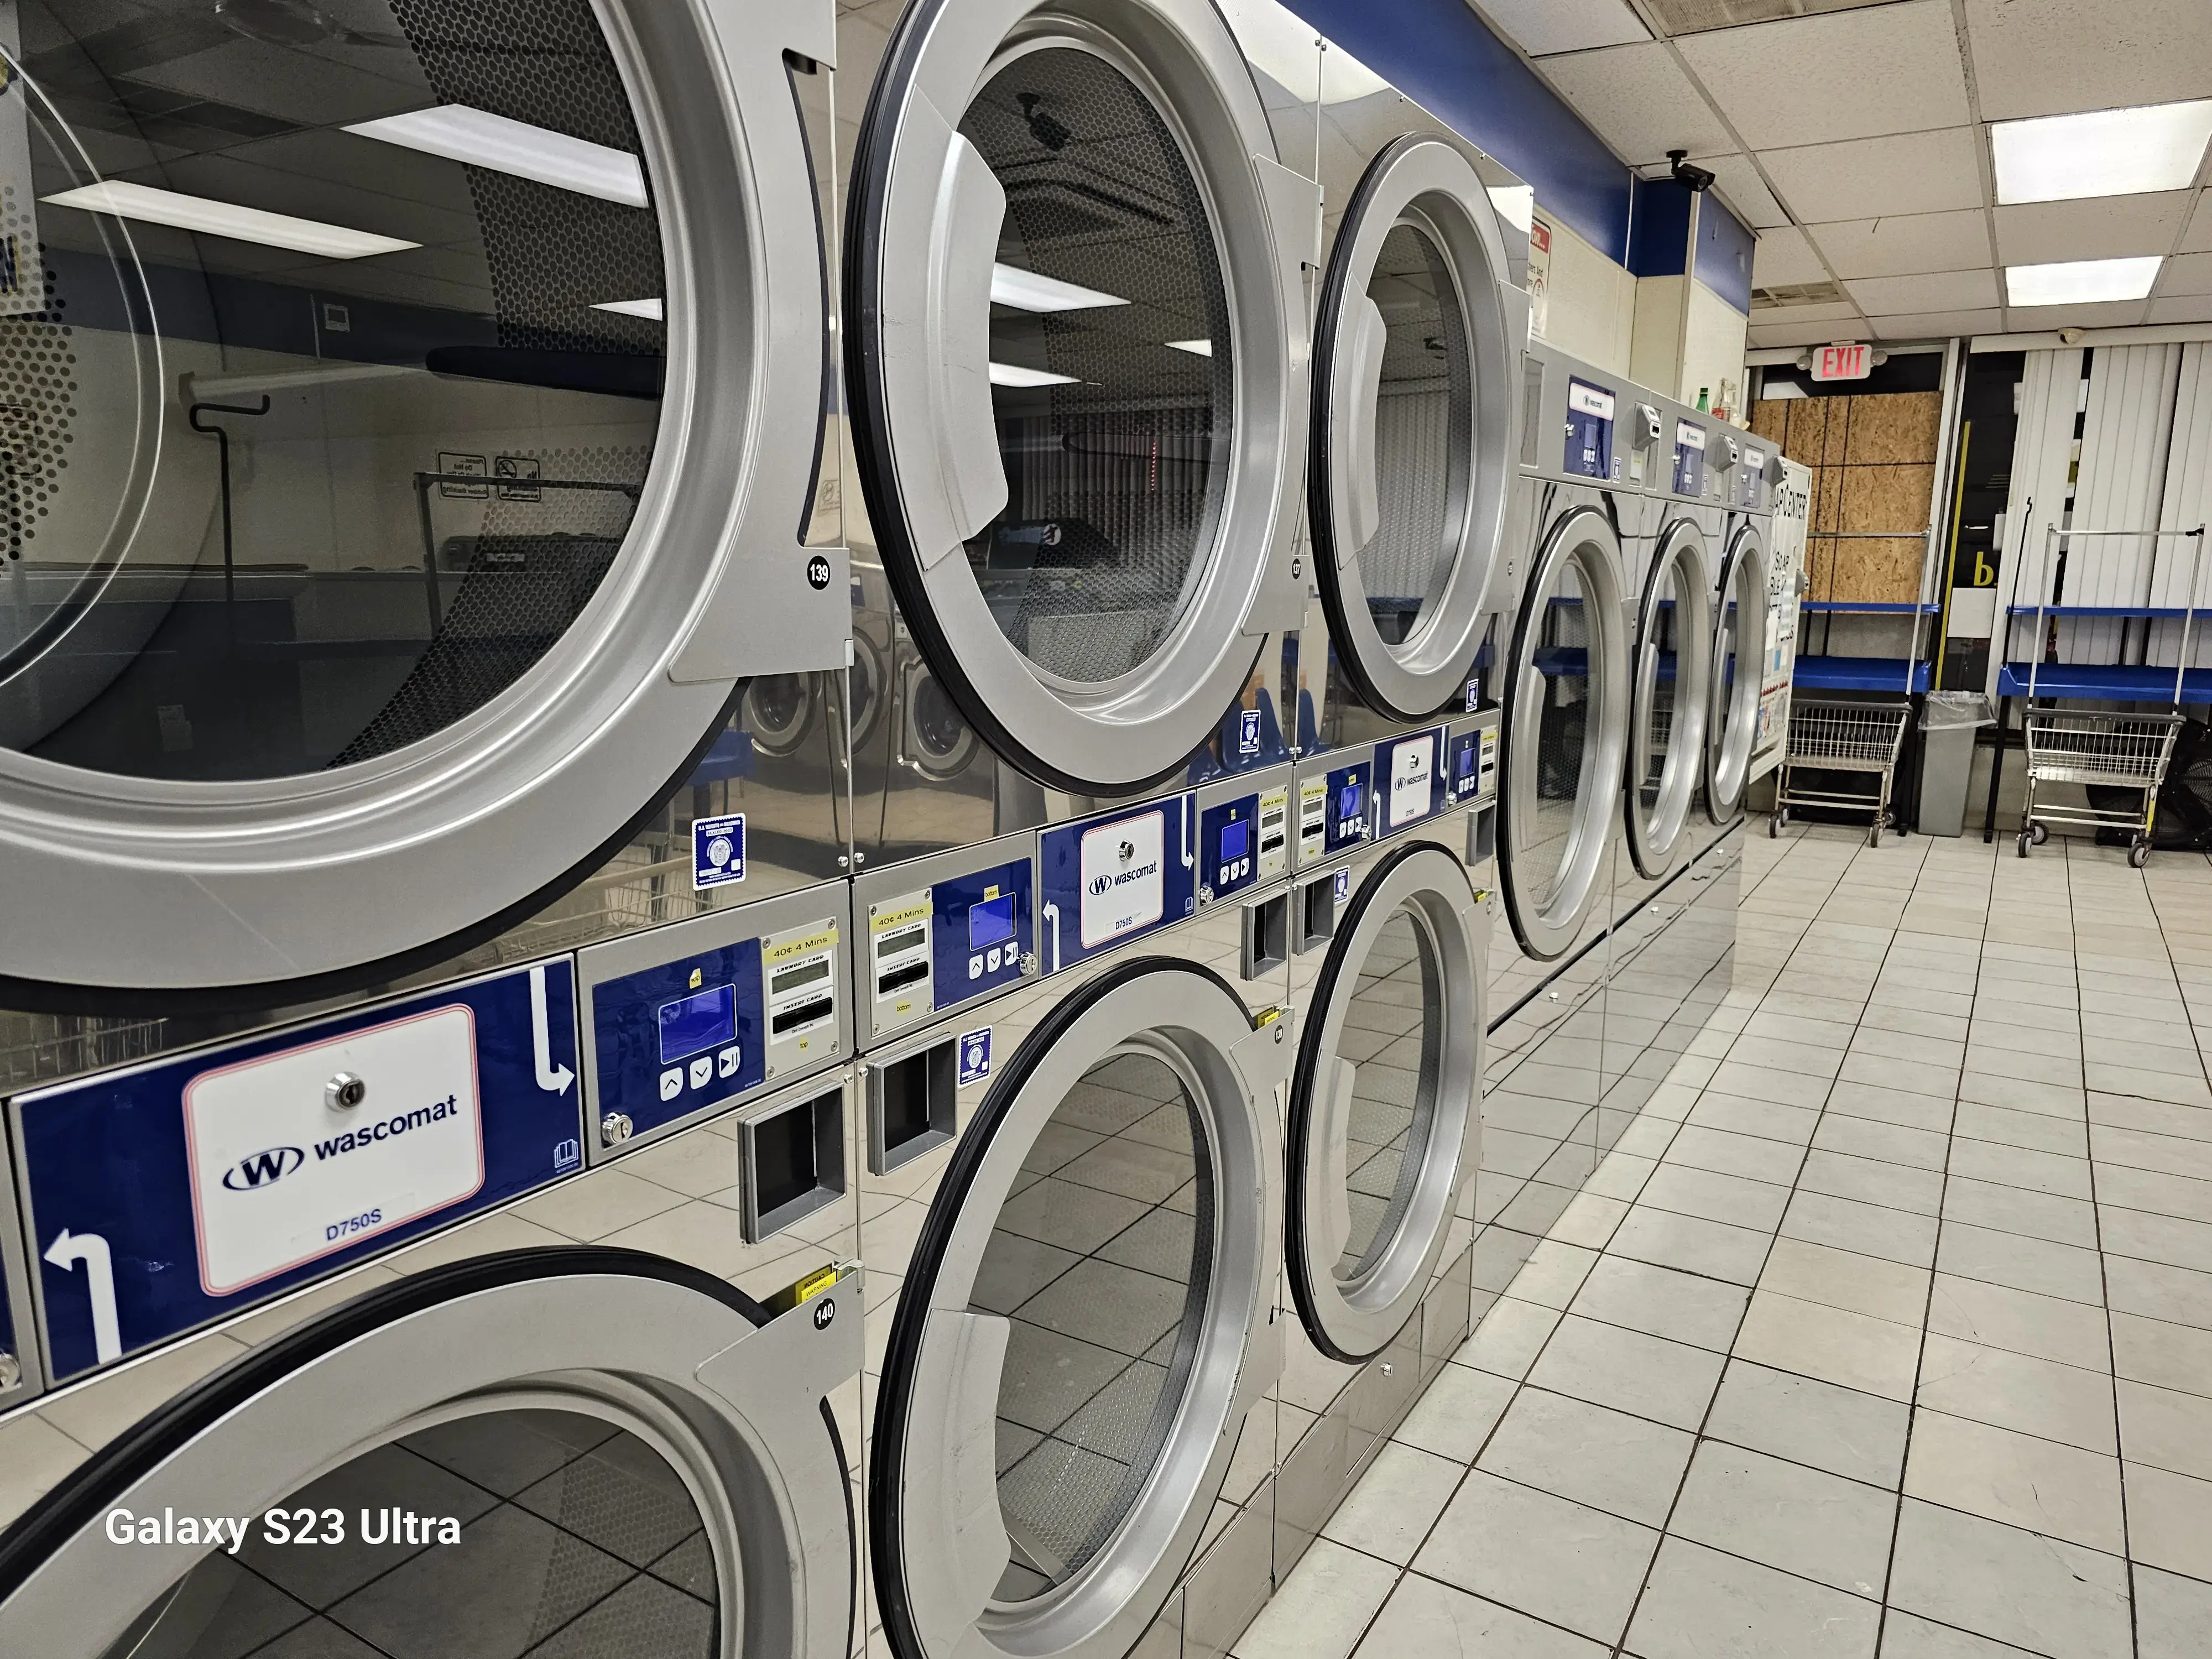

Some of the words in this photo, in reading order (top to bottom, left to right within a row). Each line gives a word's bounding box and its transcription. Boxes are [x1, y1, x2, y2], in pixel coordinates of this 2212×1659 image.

[1822, 347, 1864, 378] EXIT
[810, 564, 828, 582] 139
[1406, 771, 1428, 786] wascomat
[1114, 860, 1157, 886] wascomat
[878, 917, 895, 926] 40¢
[904, 909, 924, 919] Mins
[1115, 916, 1133, 930] D750S
[881, 928, 906, 939] LAUNDRY
[774, 947, 792, 957] 40¢
[805, 937, 828, 948] Mins
[776, 961, 807, 973] LAUNDRY
[808, 954, 824, 963] CARD
[886, 962, 905, 972] INSERT
[783, 1000, 805, 1011] INSERT
[806, 993, 822, 1003] CARD
[314, 1094, 458, 1161] wascomat
[325, 1208, 383, 1241] D750S
[816, 1303, 833, 1324] 140
